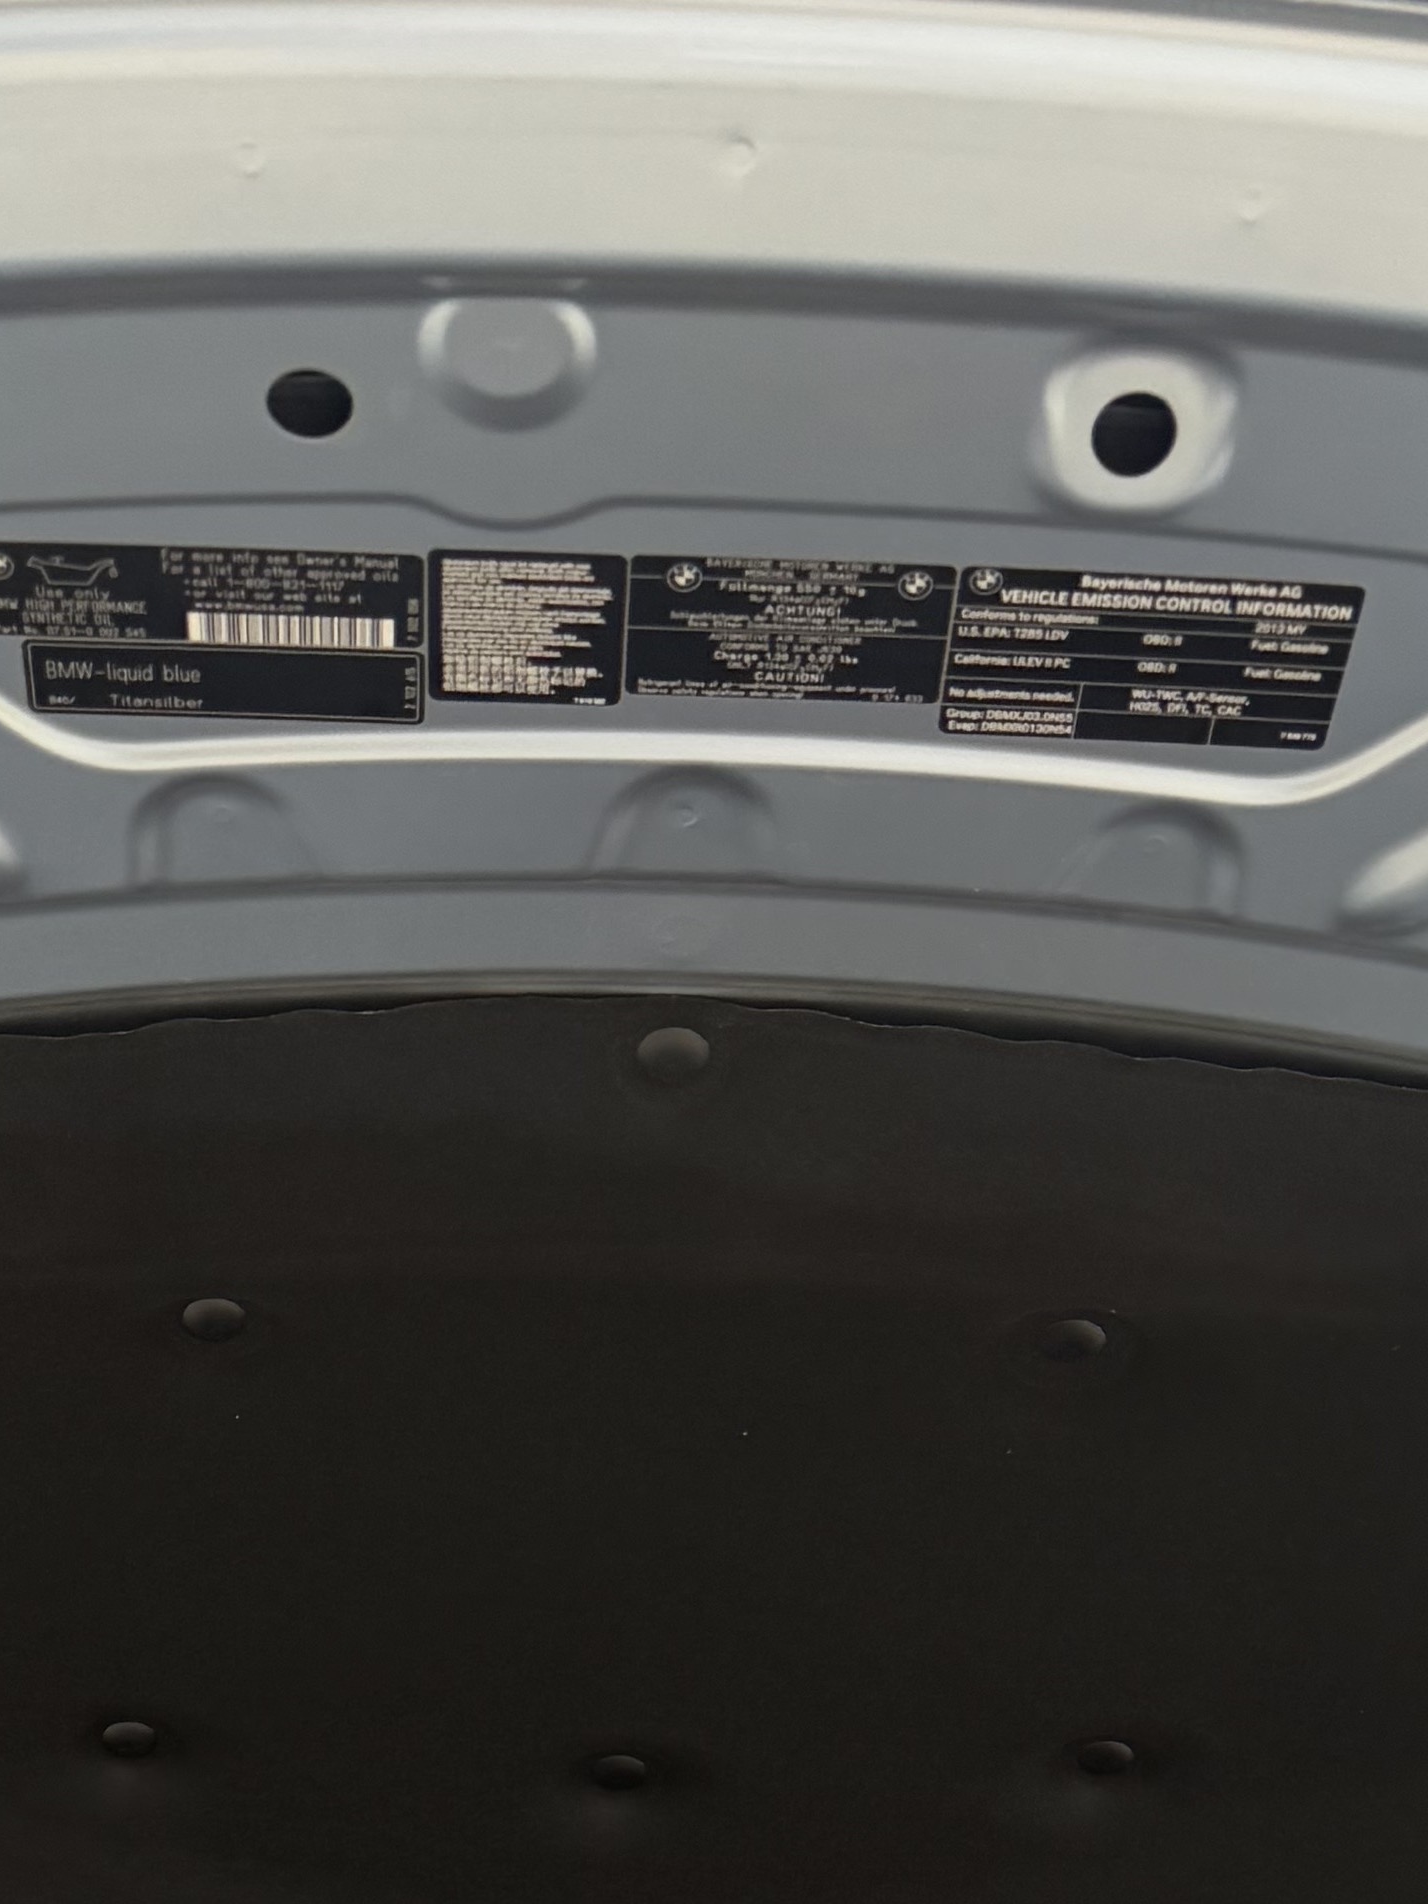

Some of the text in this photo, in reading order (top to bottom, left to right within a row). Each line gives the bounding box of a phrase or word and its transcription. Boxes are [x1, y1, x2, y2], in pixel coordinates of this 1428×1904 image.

[192, 552, 224, 563] more
[233, 552, 259, 564] info
[354, 556, 399, 569] Manual
[263, 566, 297, 578] other
[306, 569, 366, 582] approved
[35, 585, 111, 601] Use only
[1081, 575, 1303, 599] Bayerische Motoren Werke AG
[1001, 589, 1354, 621] VEHICLE EMISSION CONTROL INFORMATION
[961, 608, 1016, 621] Conforms
[1280, 641, 1330, 655] Gasoline
[45, 660, 201, 684] BMW-liquid blue
[1273, 668, 1322, 682] Gasoline
